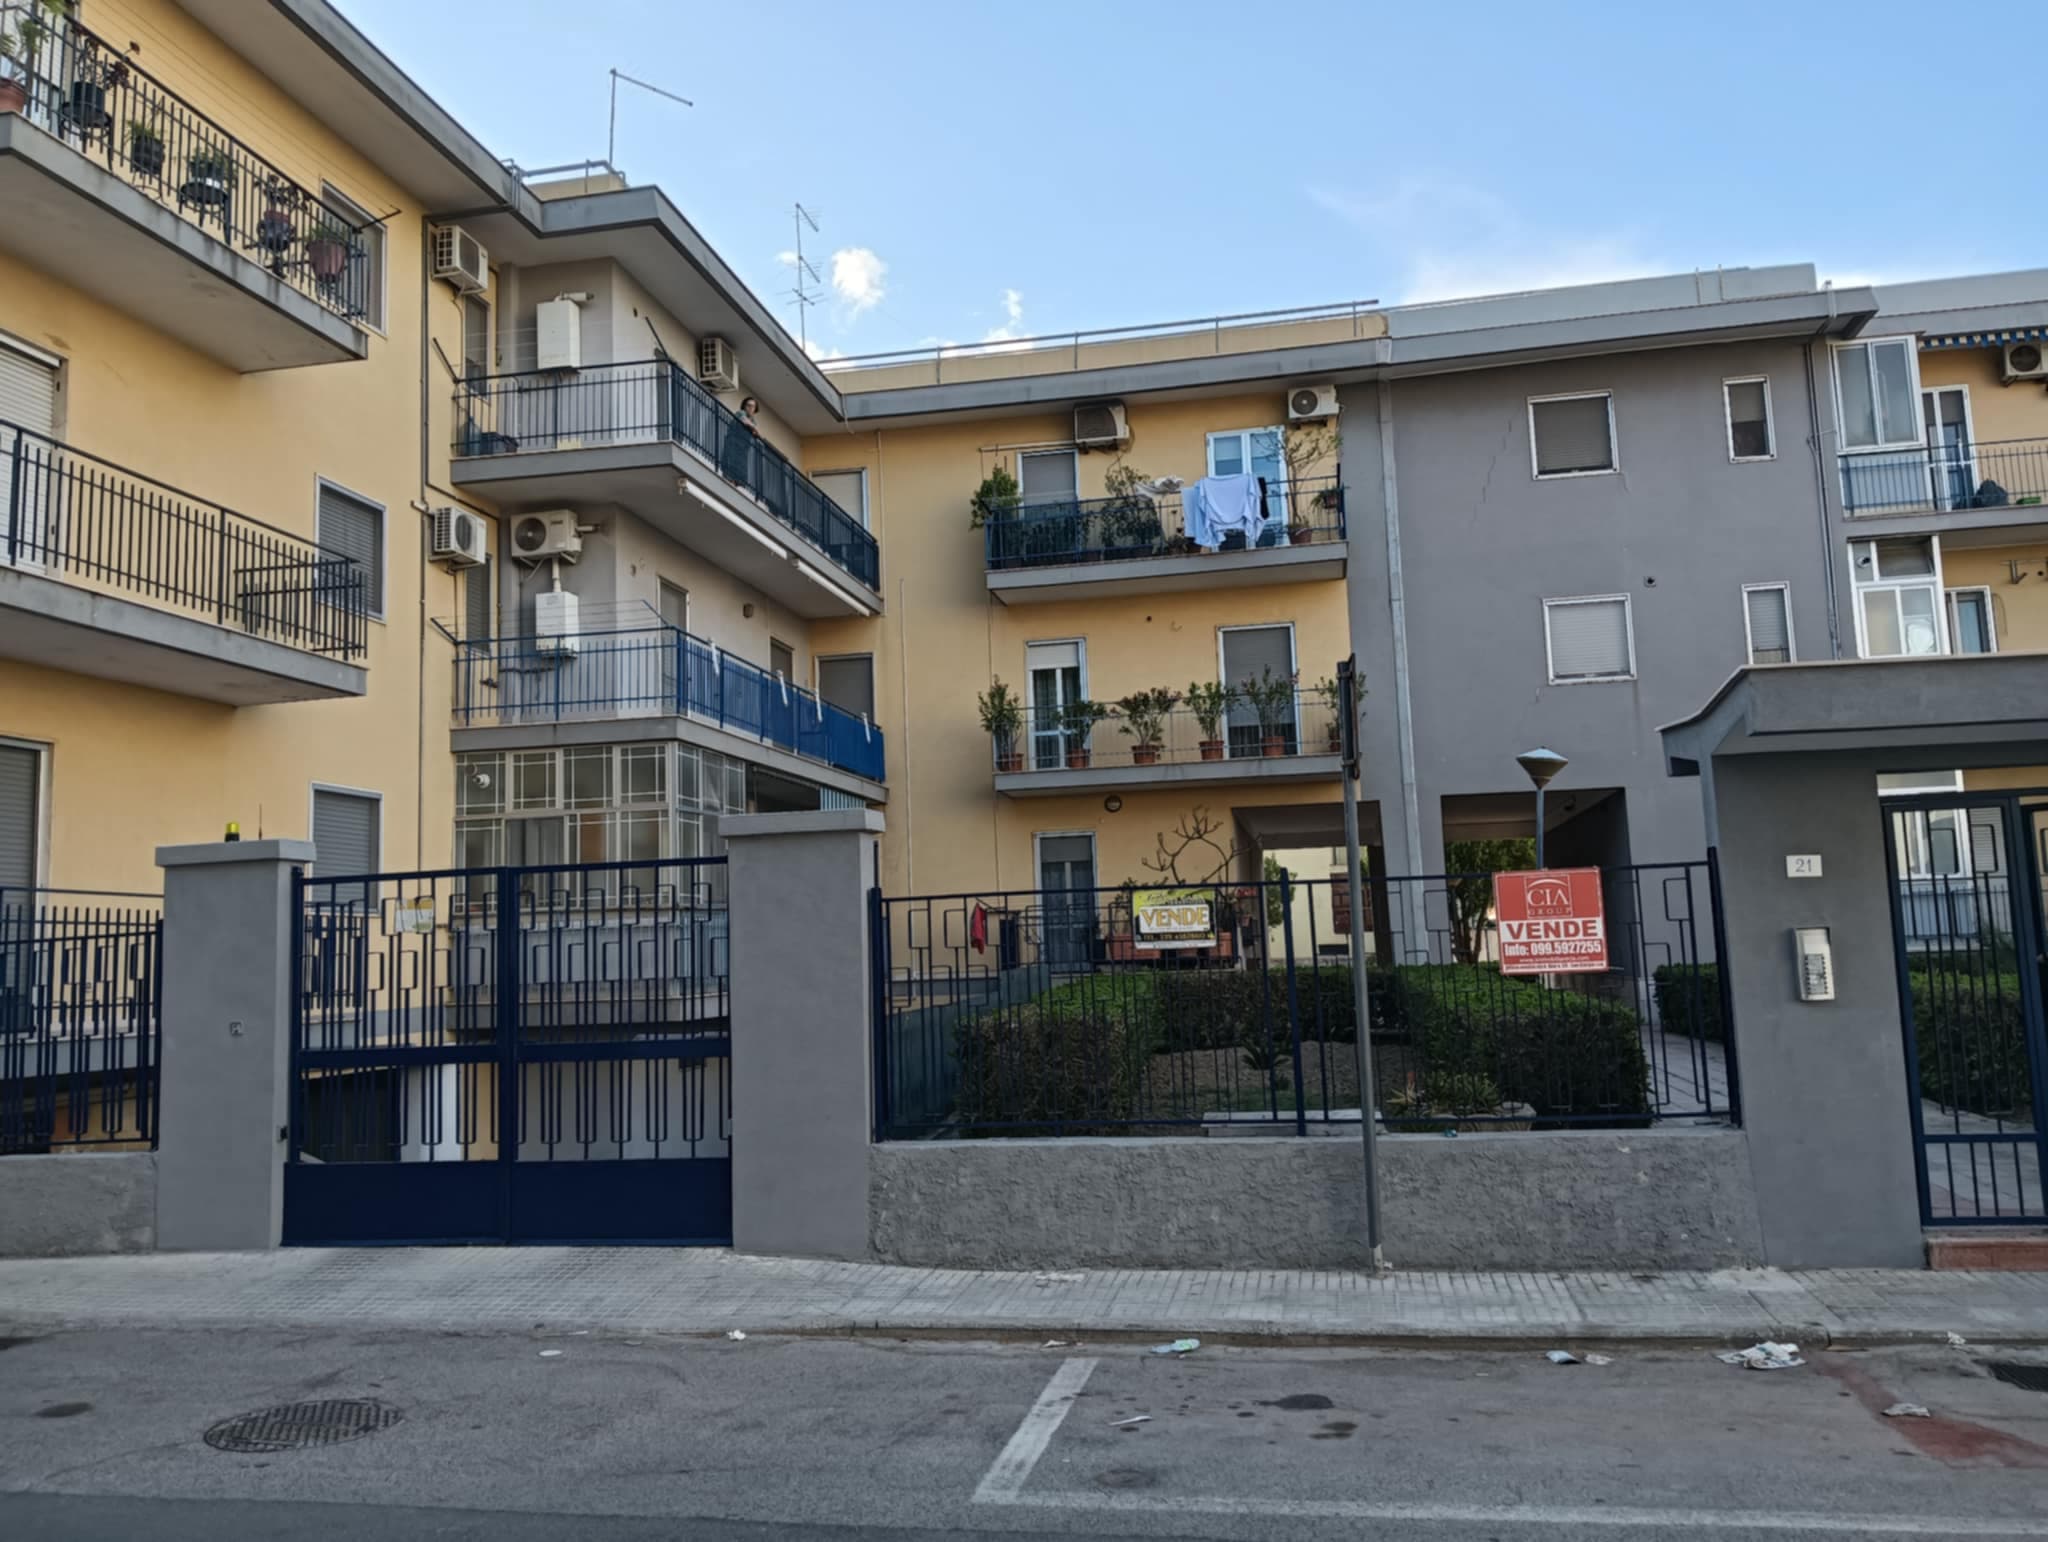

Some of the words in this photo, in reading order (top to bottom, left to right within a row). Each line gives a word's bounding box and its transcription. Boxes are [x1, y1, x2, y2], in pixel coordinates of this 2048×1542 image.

[1795, 858, 1812, 873] 21
[1527, 888, 1569, 906] CIA
[1140, 906, 1209, 928] VENDE
[1506, 920, 1598, 940] VENDE
[1504, 943, 1529, 957] Info:
